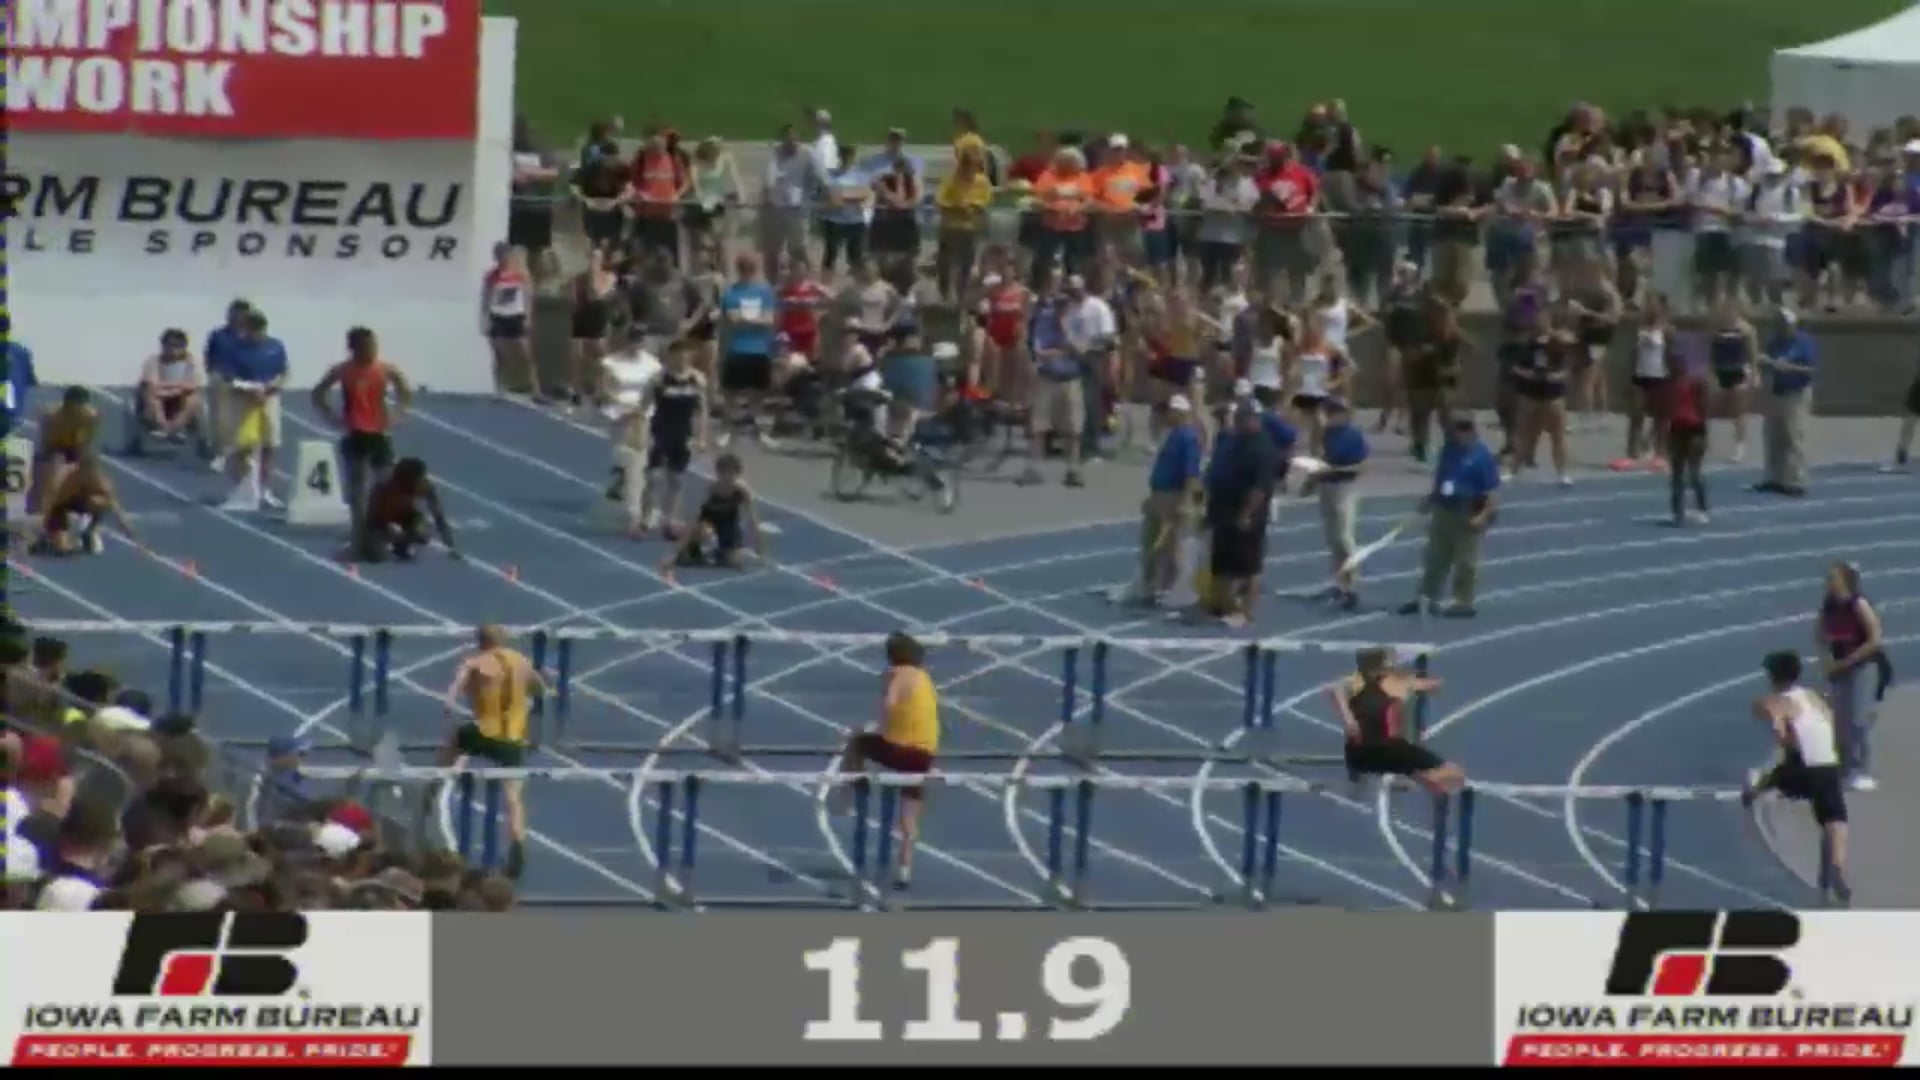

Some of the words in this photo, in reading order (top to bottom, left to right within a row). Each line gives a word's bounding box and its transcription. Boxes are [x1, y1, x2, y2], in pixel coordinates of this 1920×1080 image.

[6, 0, 446, 59] MPIONSHIP
[5, 55, 236, 116] WORK
[117, 176, 463, 228] BUREAU
[24, 226, 97, 253] LE
[145, 229, 458, 260] SPONSOR
[306, 459, 331, 495] 4
